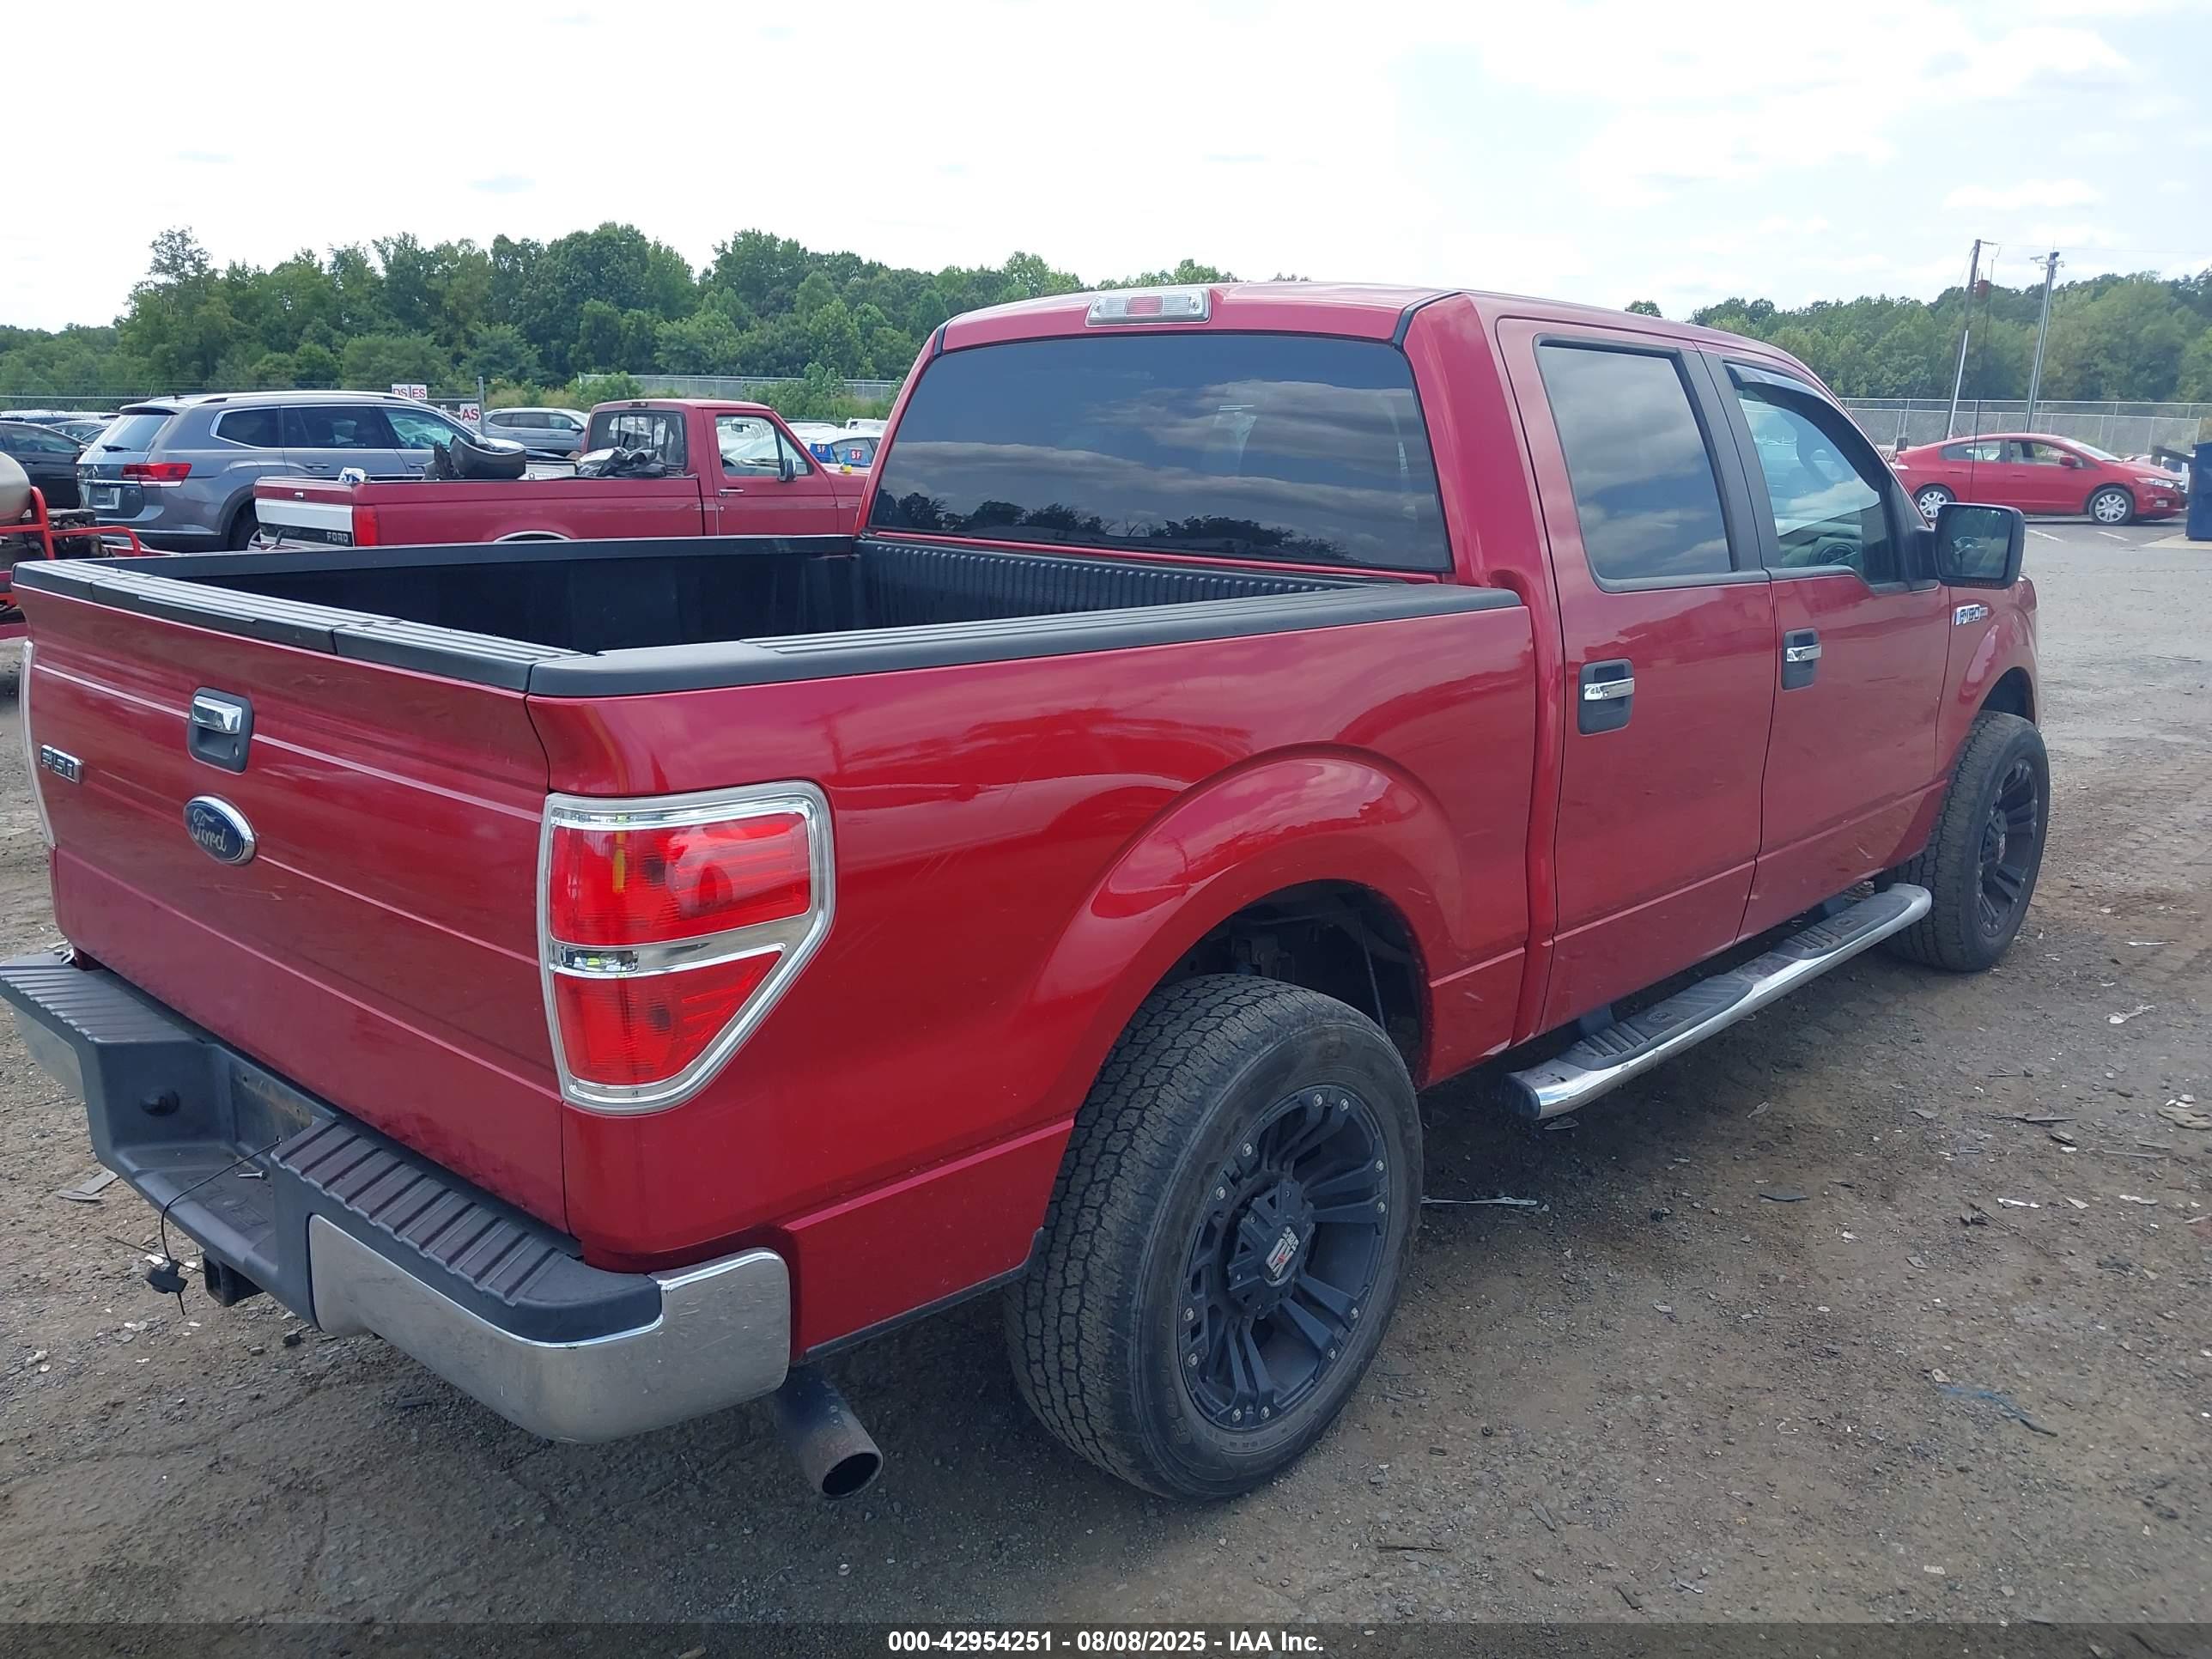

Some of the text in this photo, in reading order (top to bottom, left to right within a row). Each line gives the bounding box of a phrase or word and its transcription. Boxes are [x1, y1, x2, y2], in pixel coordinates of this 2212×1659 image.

[412, 388, 426, 398] ES
[461, 408, 479, 421] AS
[817, 445, 826, 453] SF
[851, 451, 861, 459] SF
[326, 532, 349, 543] FORD
[191, 808, 228, 853] Ford
